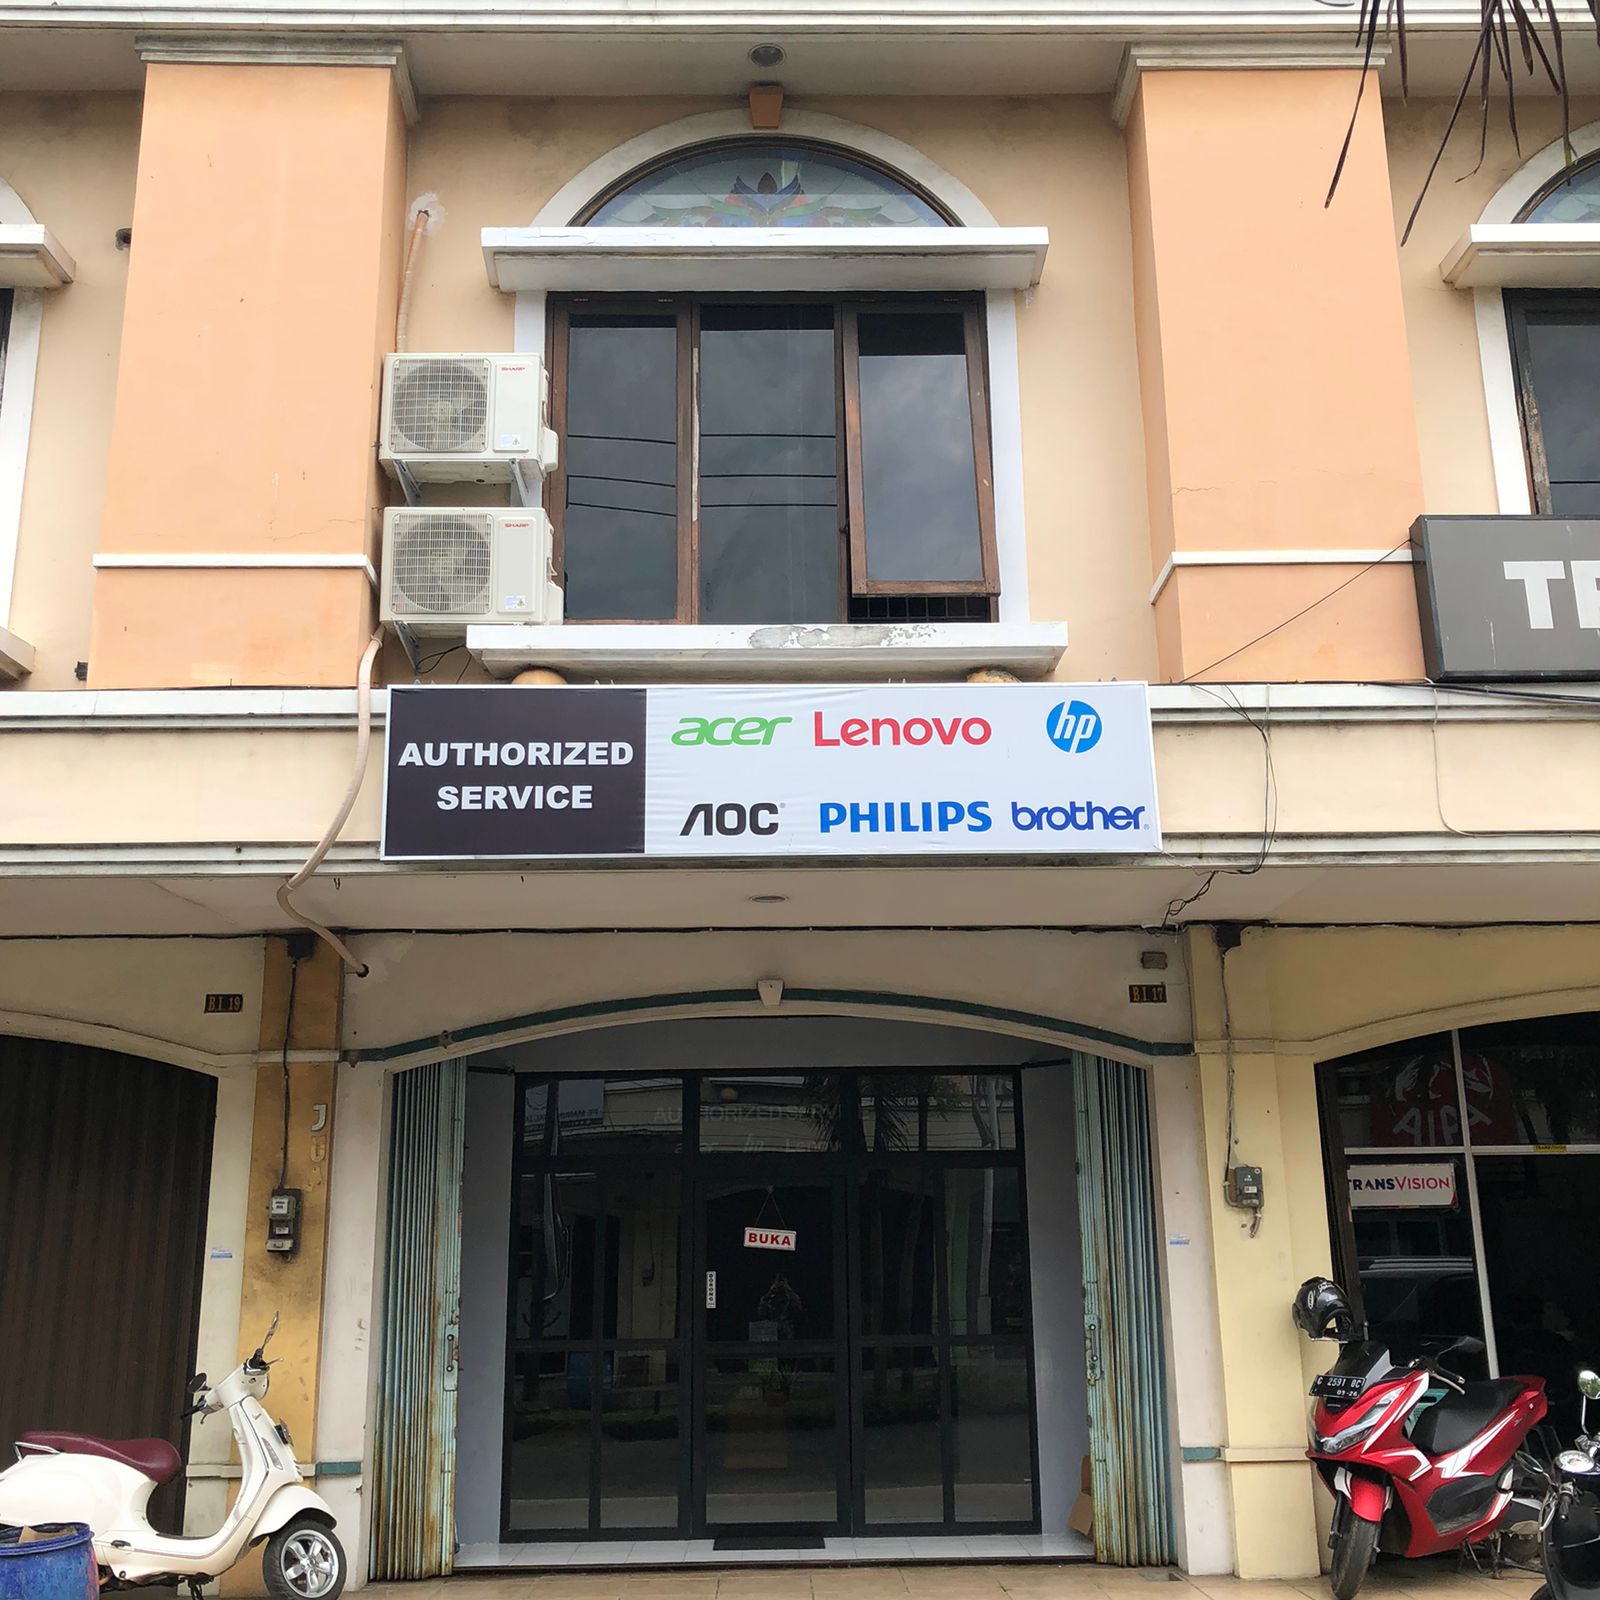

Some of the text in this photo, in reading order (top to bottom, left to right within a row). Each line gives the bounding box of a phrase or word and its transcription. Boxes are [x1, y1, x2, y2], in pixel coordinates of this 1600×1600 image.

[671, 716, 792, 747] acer
[814, 711, 992, 747] Lenovo
[1053, 698, 1098, 754] hp
[398, 742, 634, 767] AUTHORIZED
[437, 785, 593, 811] SERVICE
[679, 803, 779, 837] AOC
[820, 801, 993, 834] PHILIPS
[1012, 801, 1146, 831] brother
[228, 996, 241, 1011] 19
[748, 1232, 791, 1246] BUKA
[1327, 1377, 1347, 1387] 2591
